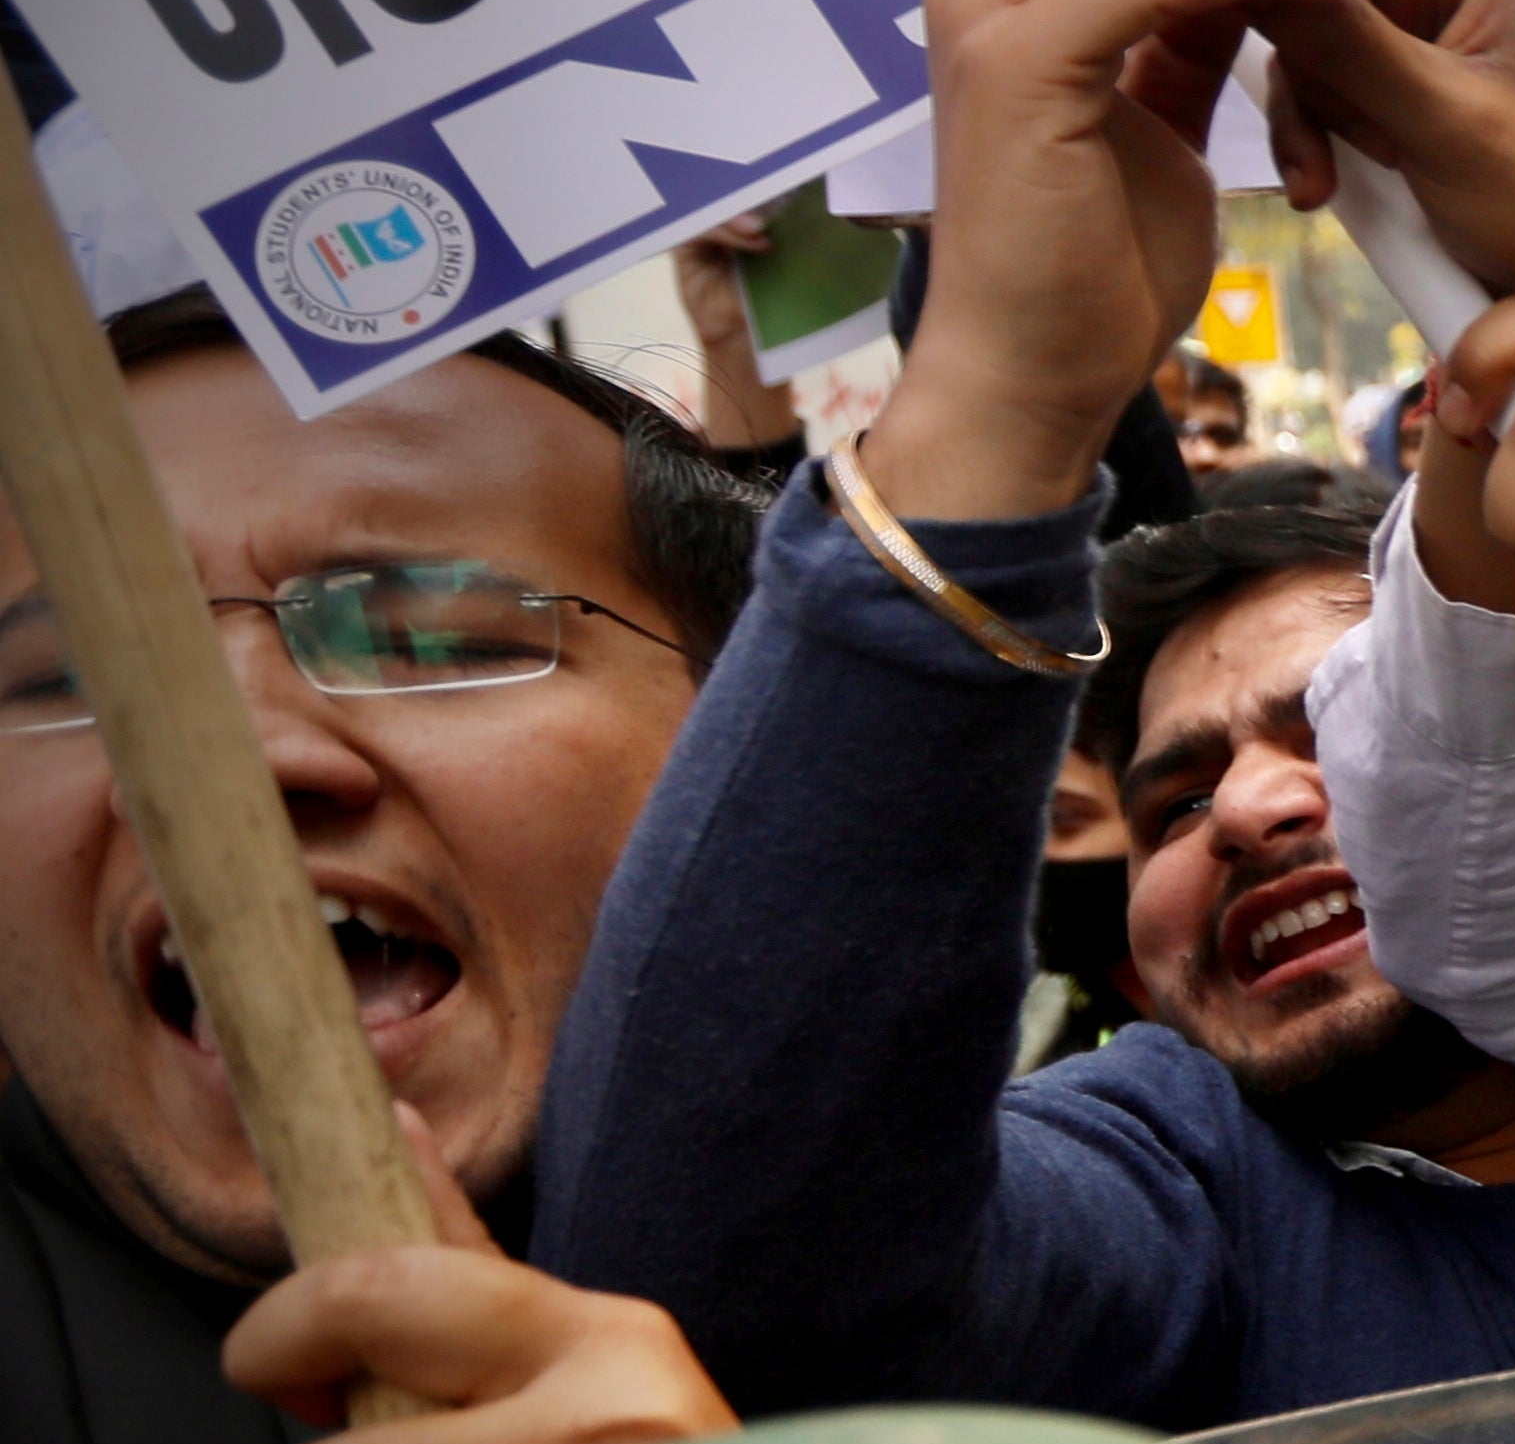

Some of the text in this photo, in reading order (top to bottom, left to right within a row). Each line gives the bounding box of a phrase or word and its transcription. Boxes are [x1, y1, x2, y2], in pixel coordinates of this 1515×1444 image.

[363, 169, 441, 209] UNION
[435, 209, 463, 237] OF
[429, 244, 464, 300] INDIA
[272, 269, 379, 335] NATIONAL
